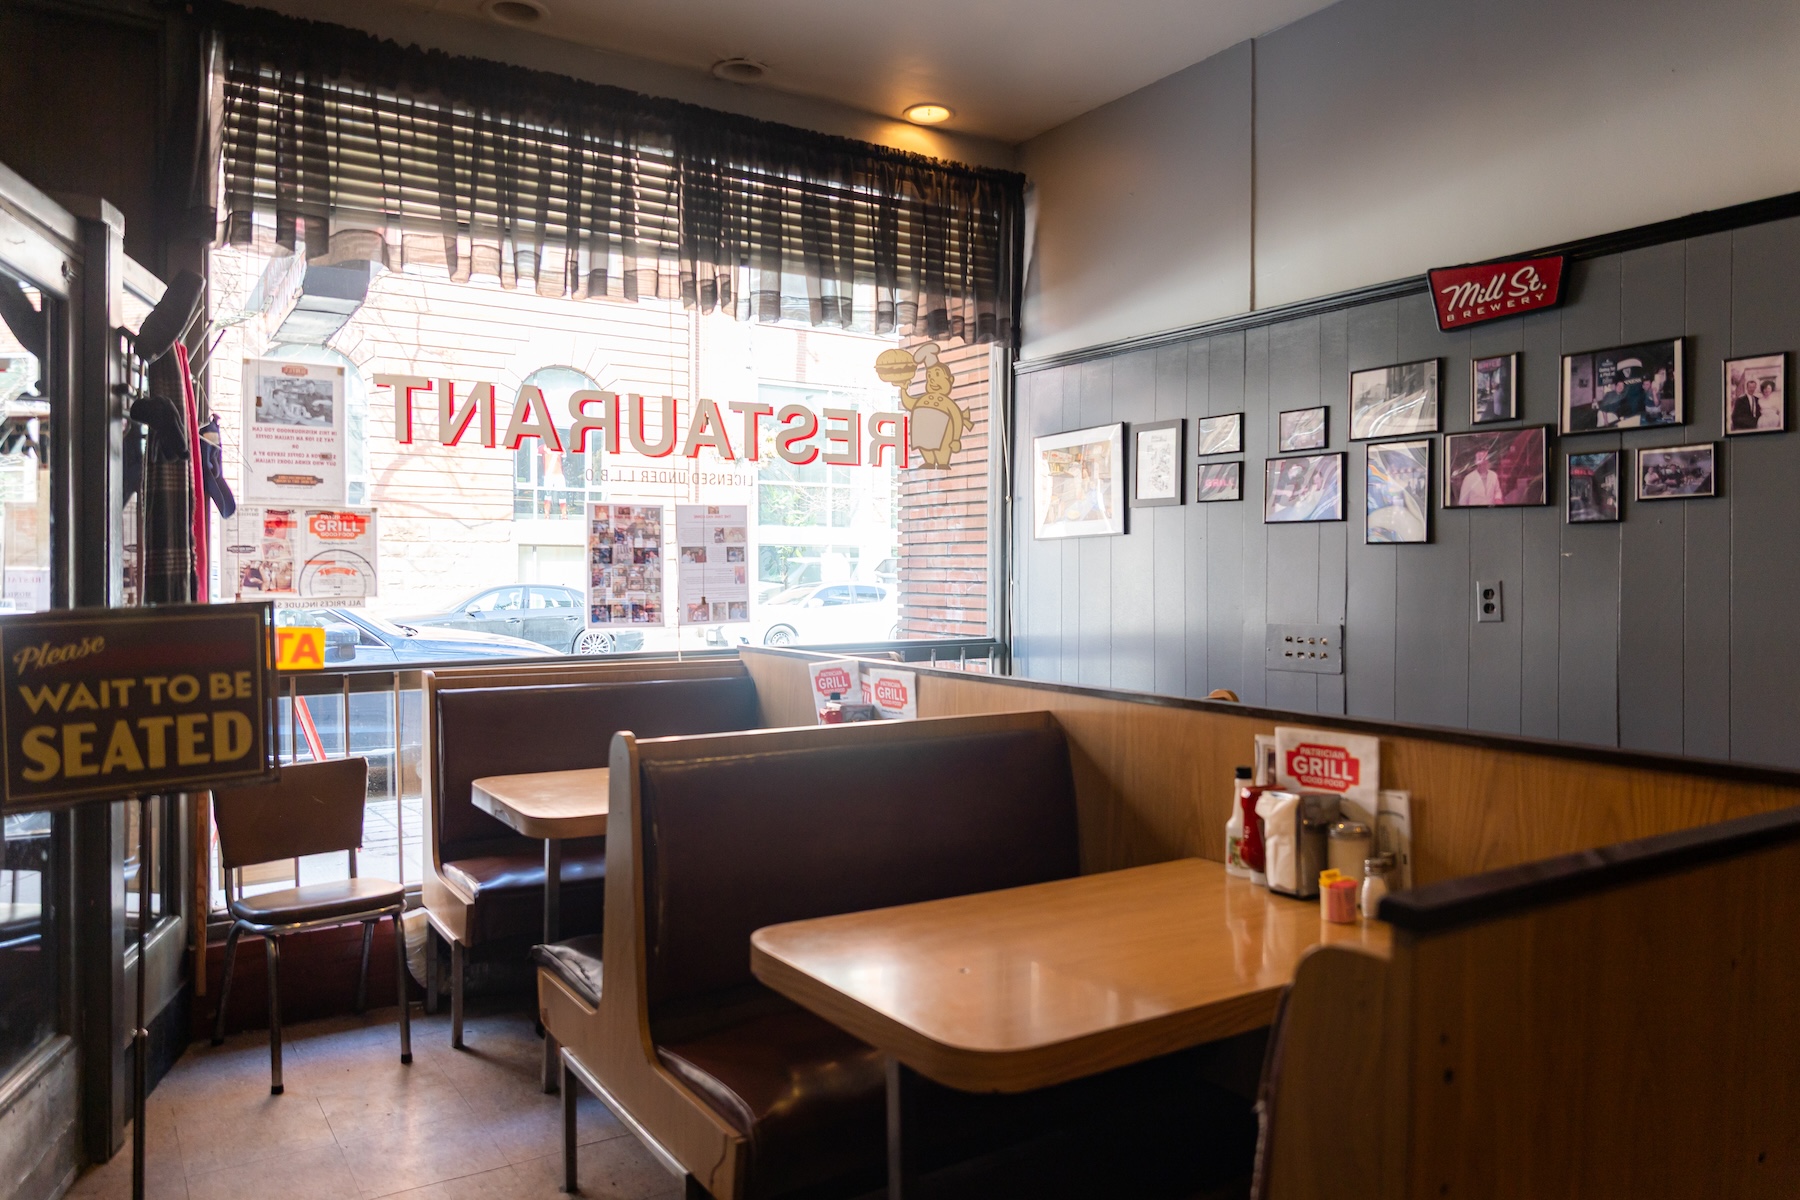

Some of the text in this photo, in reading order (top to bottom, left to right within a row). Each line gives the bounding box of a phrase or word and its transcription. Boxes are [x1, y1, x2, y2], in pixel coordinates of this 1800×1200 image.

[1441, 265, 1547, 312] Mill St.
[1446, 293, 1544, 322] BREWERY
[314, 520, 361, 533] GRILL
[13, 635, 105, 676] Please
[18, 671, 252, 715] WAIT TO BE
[818, 675, 848, 690] GRILL
[877, 687, 905, 702] GRILL
[20, 711, 253, 782] SEATED
[1299, 746, 1345, 759] PATRICIAN
[1292, 755, 1354, 781] GRILL
[1300, 775, 1346, 788] GOOD FOOD
